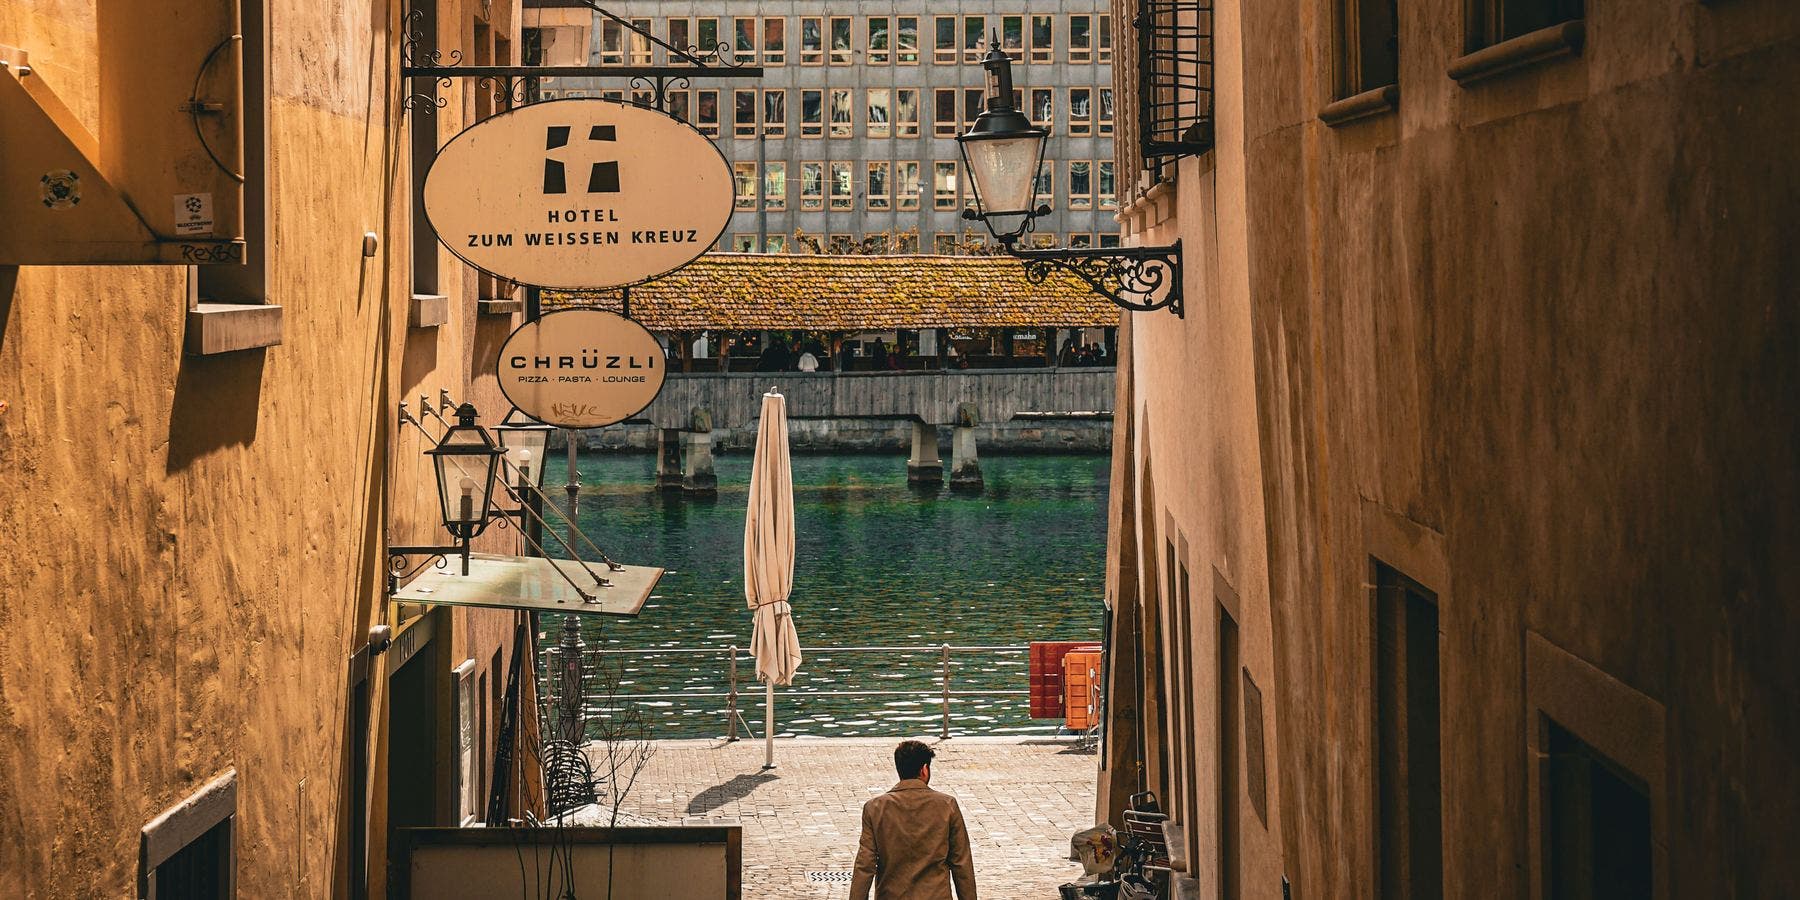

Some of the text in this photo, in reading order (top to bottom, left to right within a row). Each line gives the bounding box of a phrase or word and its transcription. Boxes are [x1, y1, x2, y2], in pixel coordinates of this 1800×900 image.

[548, 209, 618, 222] HOTEL
[468, 230, 697, 247] ZUM WEISSEN KREUZ
[510, 349, 654, 369] CHRÜZLI
[518, 375, 646, 383] PIZZA PASTA LOUNGE
